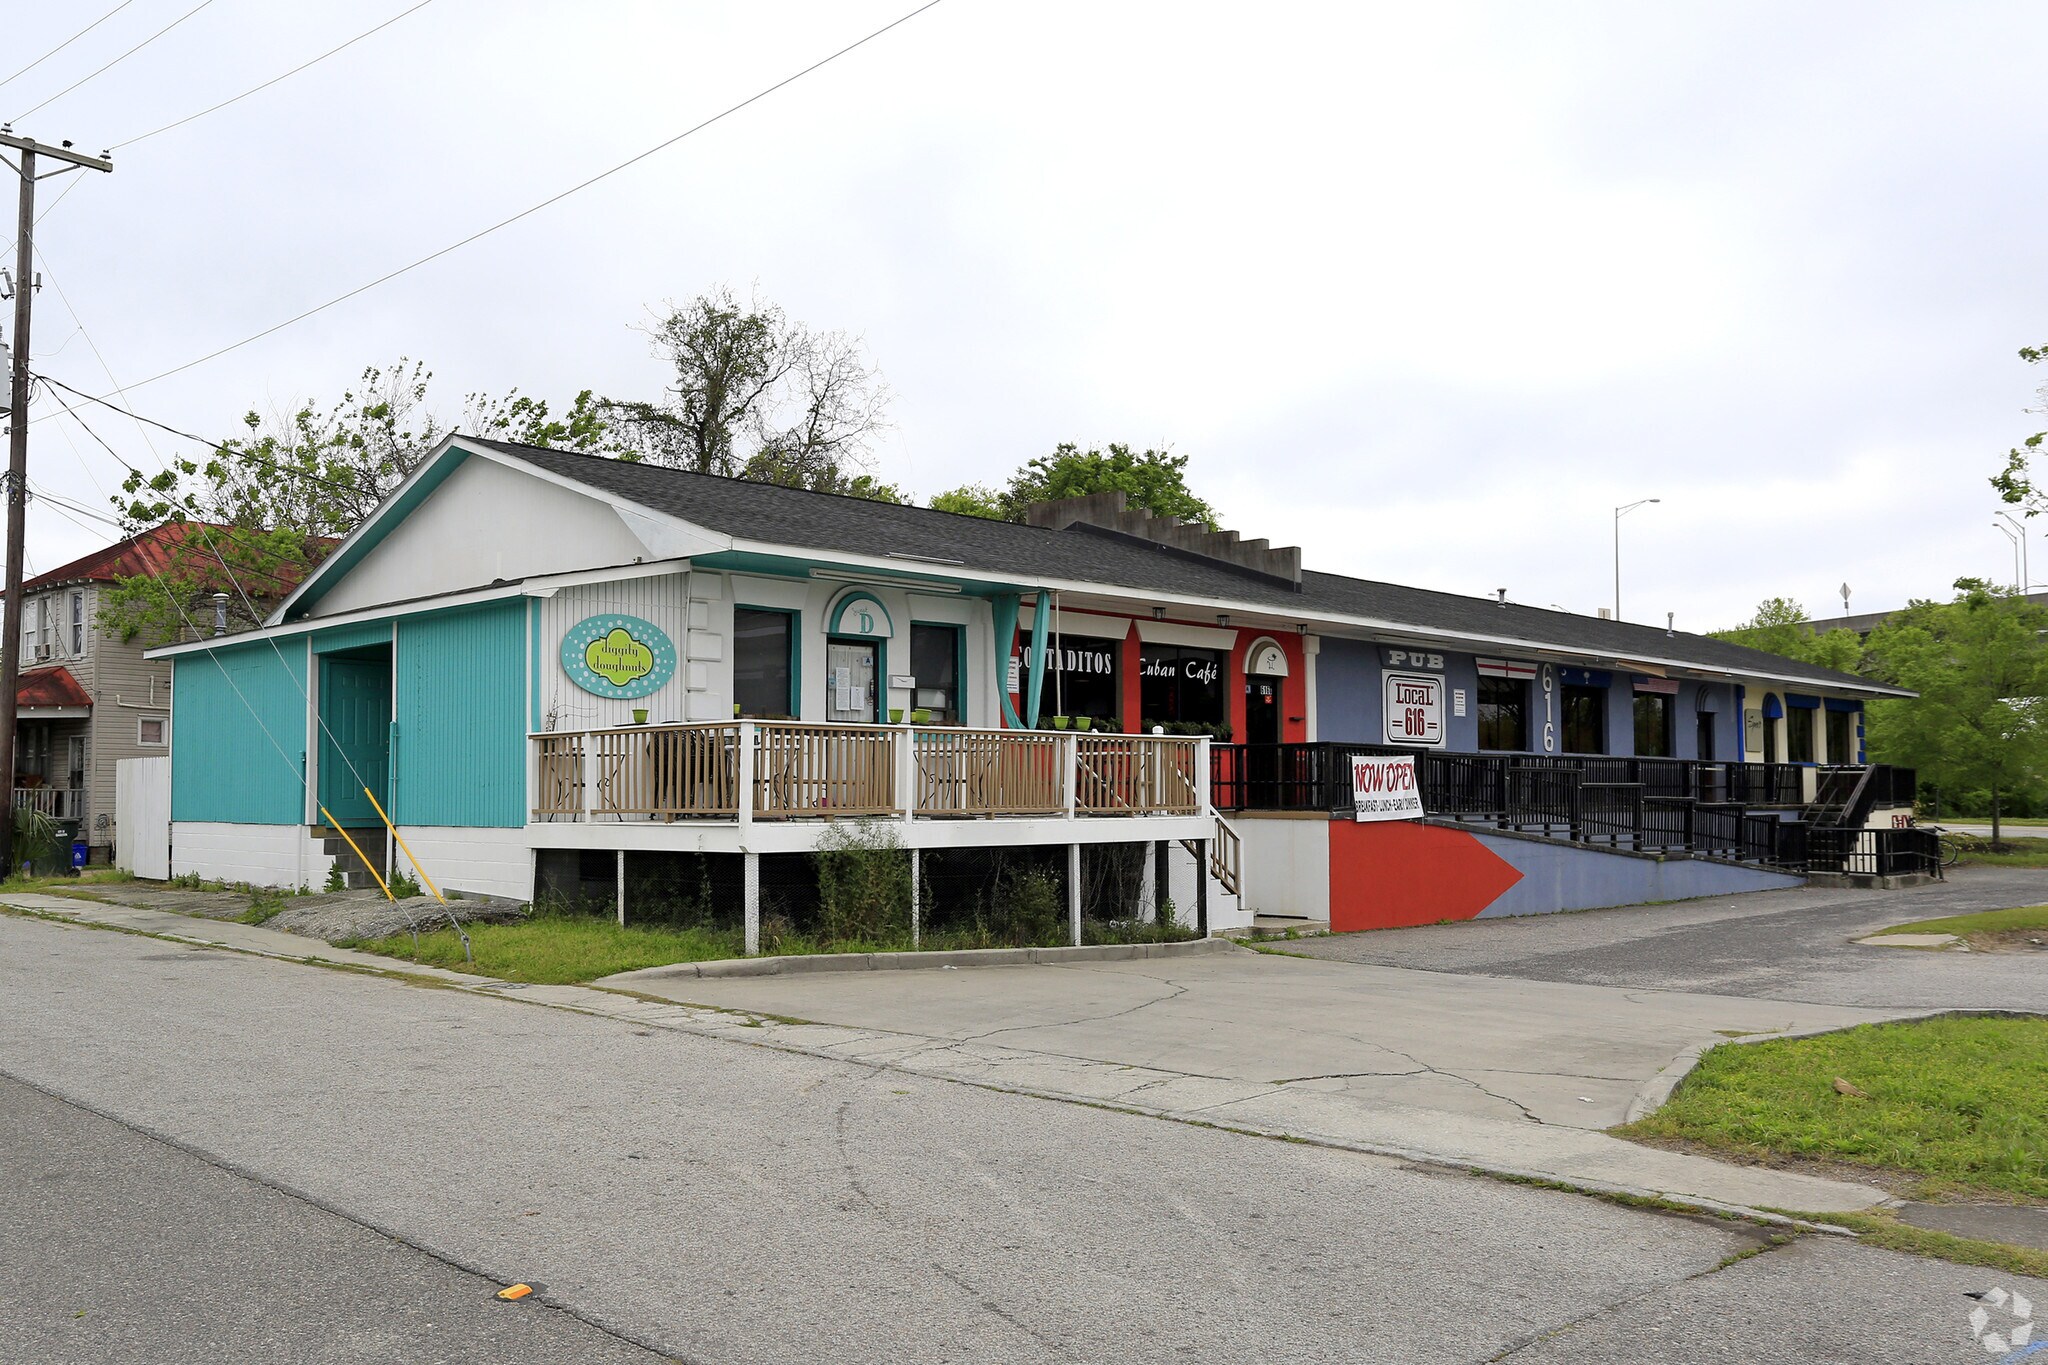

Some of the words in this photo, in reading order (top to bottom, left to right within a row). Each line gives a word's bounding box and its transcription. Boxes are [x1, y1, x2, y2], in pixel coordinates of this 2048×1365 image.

[859, 613, 874, 634] D
[602, 638, 638, 658] diggity
[1389, 650, 1444, 668] PUB
[593, 655, 647, 673] doughnuts
[1018, 646, 1112, 675] COTADITOS
[1139, 657, 1176, 677] Cuban
[1185, 661, 1218, 685] Café
[1405, 707, 1425, 736] 616
[1354, 763, 1385, 793] NOW
[1386, 763, 1415, 792] OPEN
